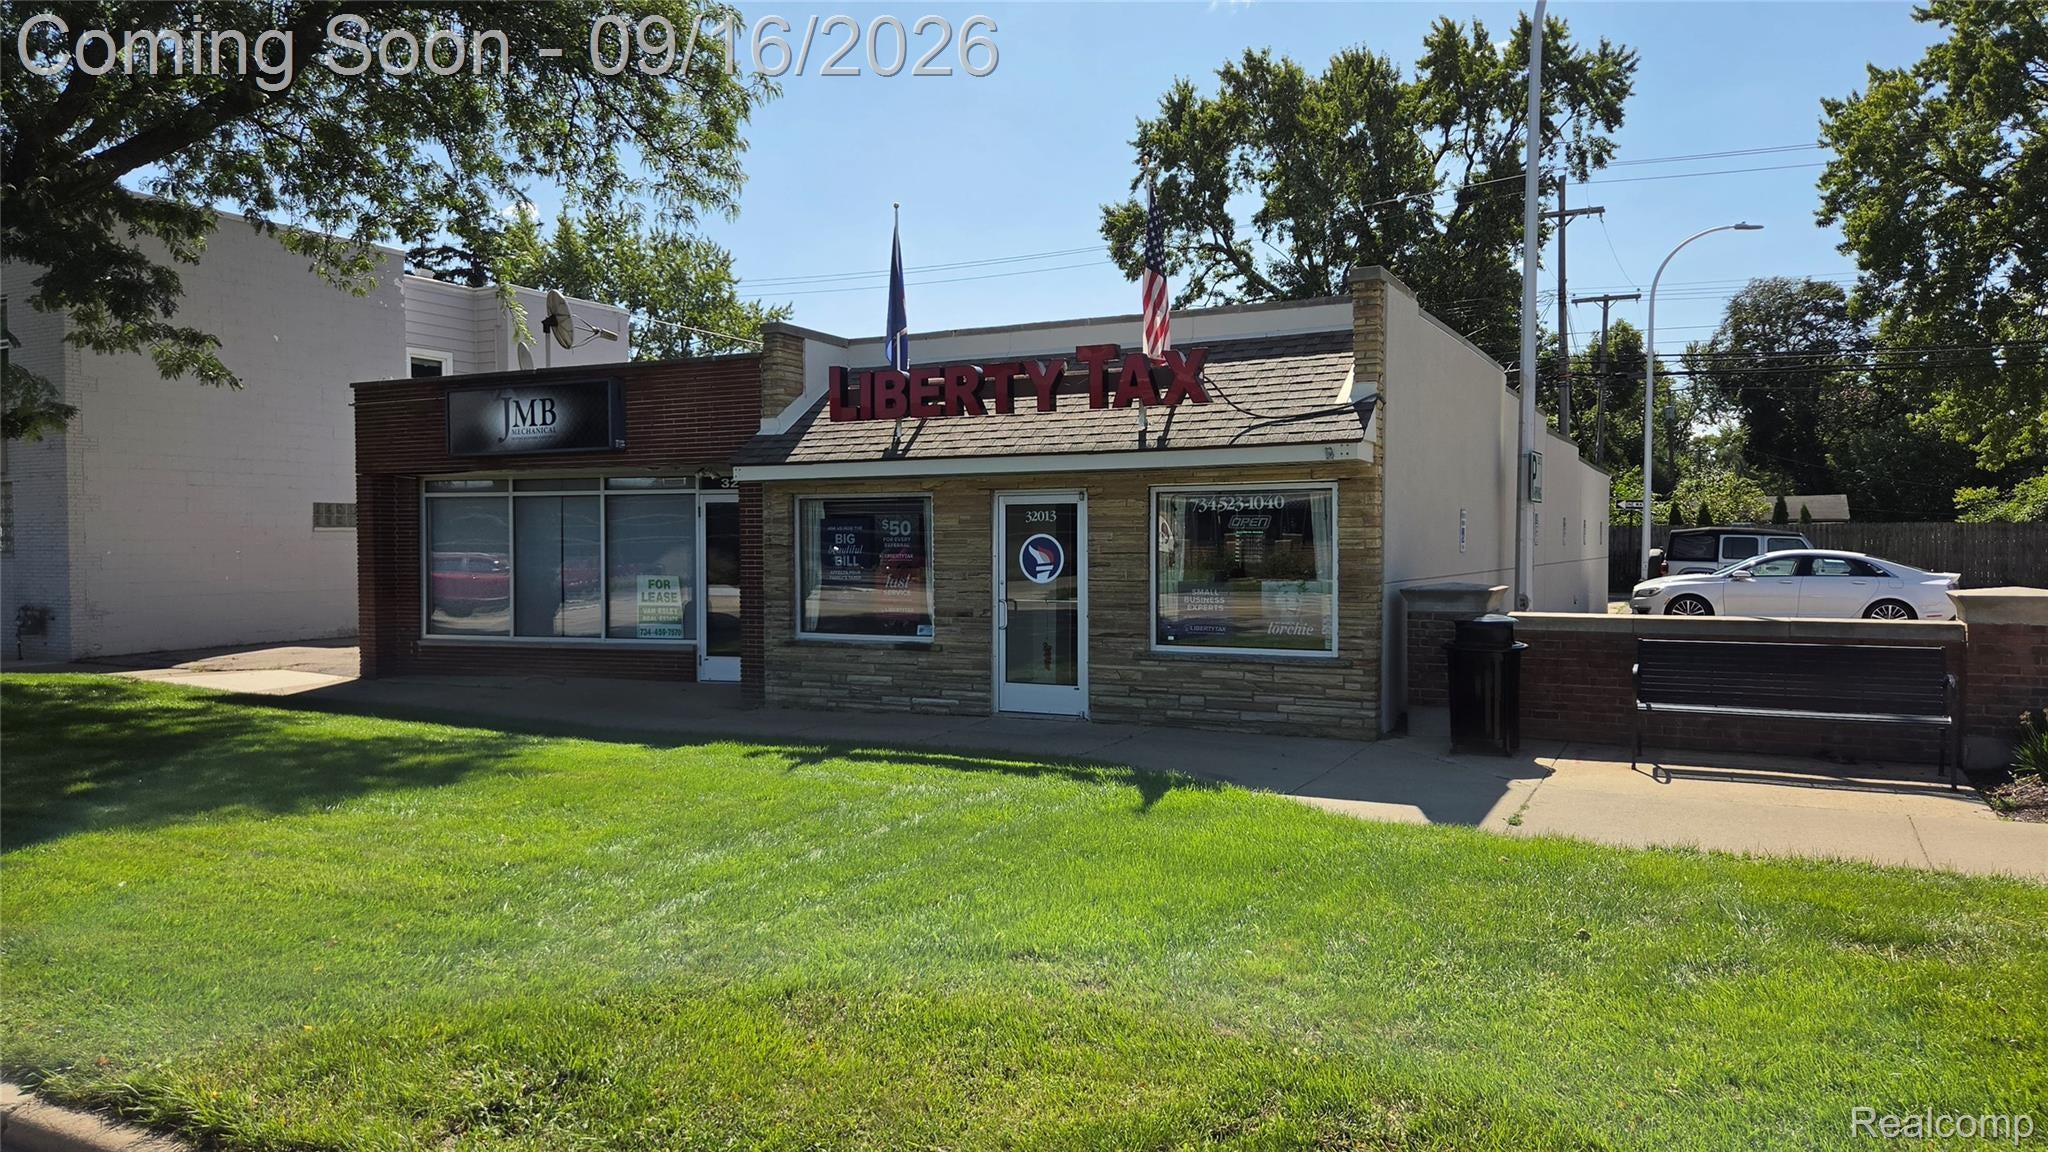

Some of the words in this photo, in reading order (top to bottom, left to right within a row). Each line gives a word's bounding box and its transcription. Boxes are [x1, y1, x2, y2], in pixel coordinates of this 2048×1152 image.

[829, 357, 1067, 422] LIBERTY
[1076, 343, 1214, 410] TAX
[497, 397, 558, 443] JMB
[511, 426, 557, 436] MECHANICAL
[1025, 509, 1057, 524] 32013
[1231, 516, 1269, 527] OPEN
[881, 519, 912, 537] $50
[835, 533, 856, 545] BIG
[834, 556, 860, 567] BILL
[648, 579, 671, 590] FOR
[641, 591, 678, 603] LEASE
[1191, 588, 1220, 596] SMALL
[1183, 596, 1225, 604] BUSINESS
[1186, 604, 1224, 612] EXPERTS
